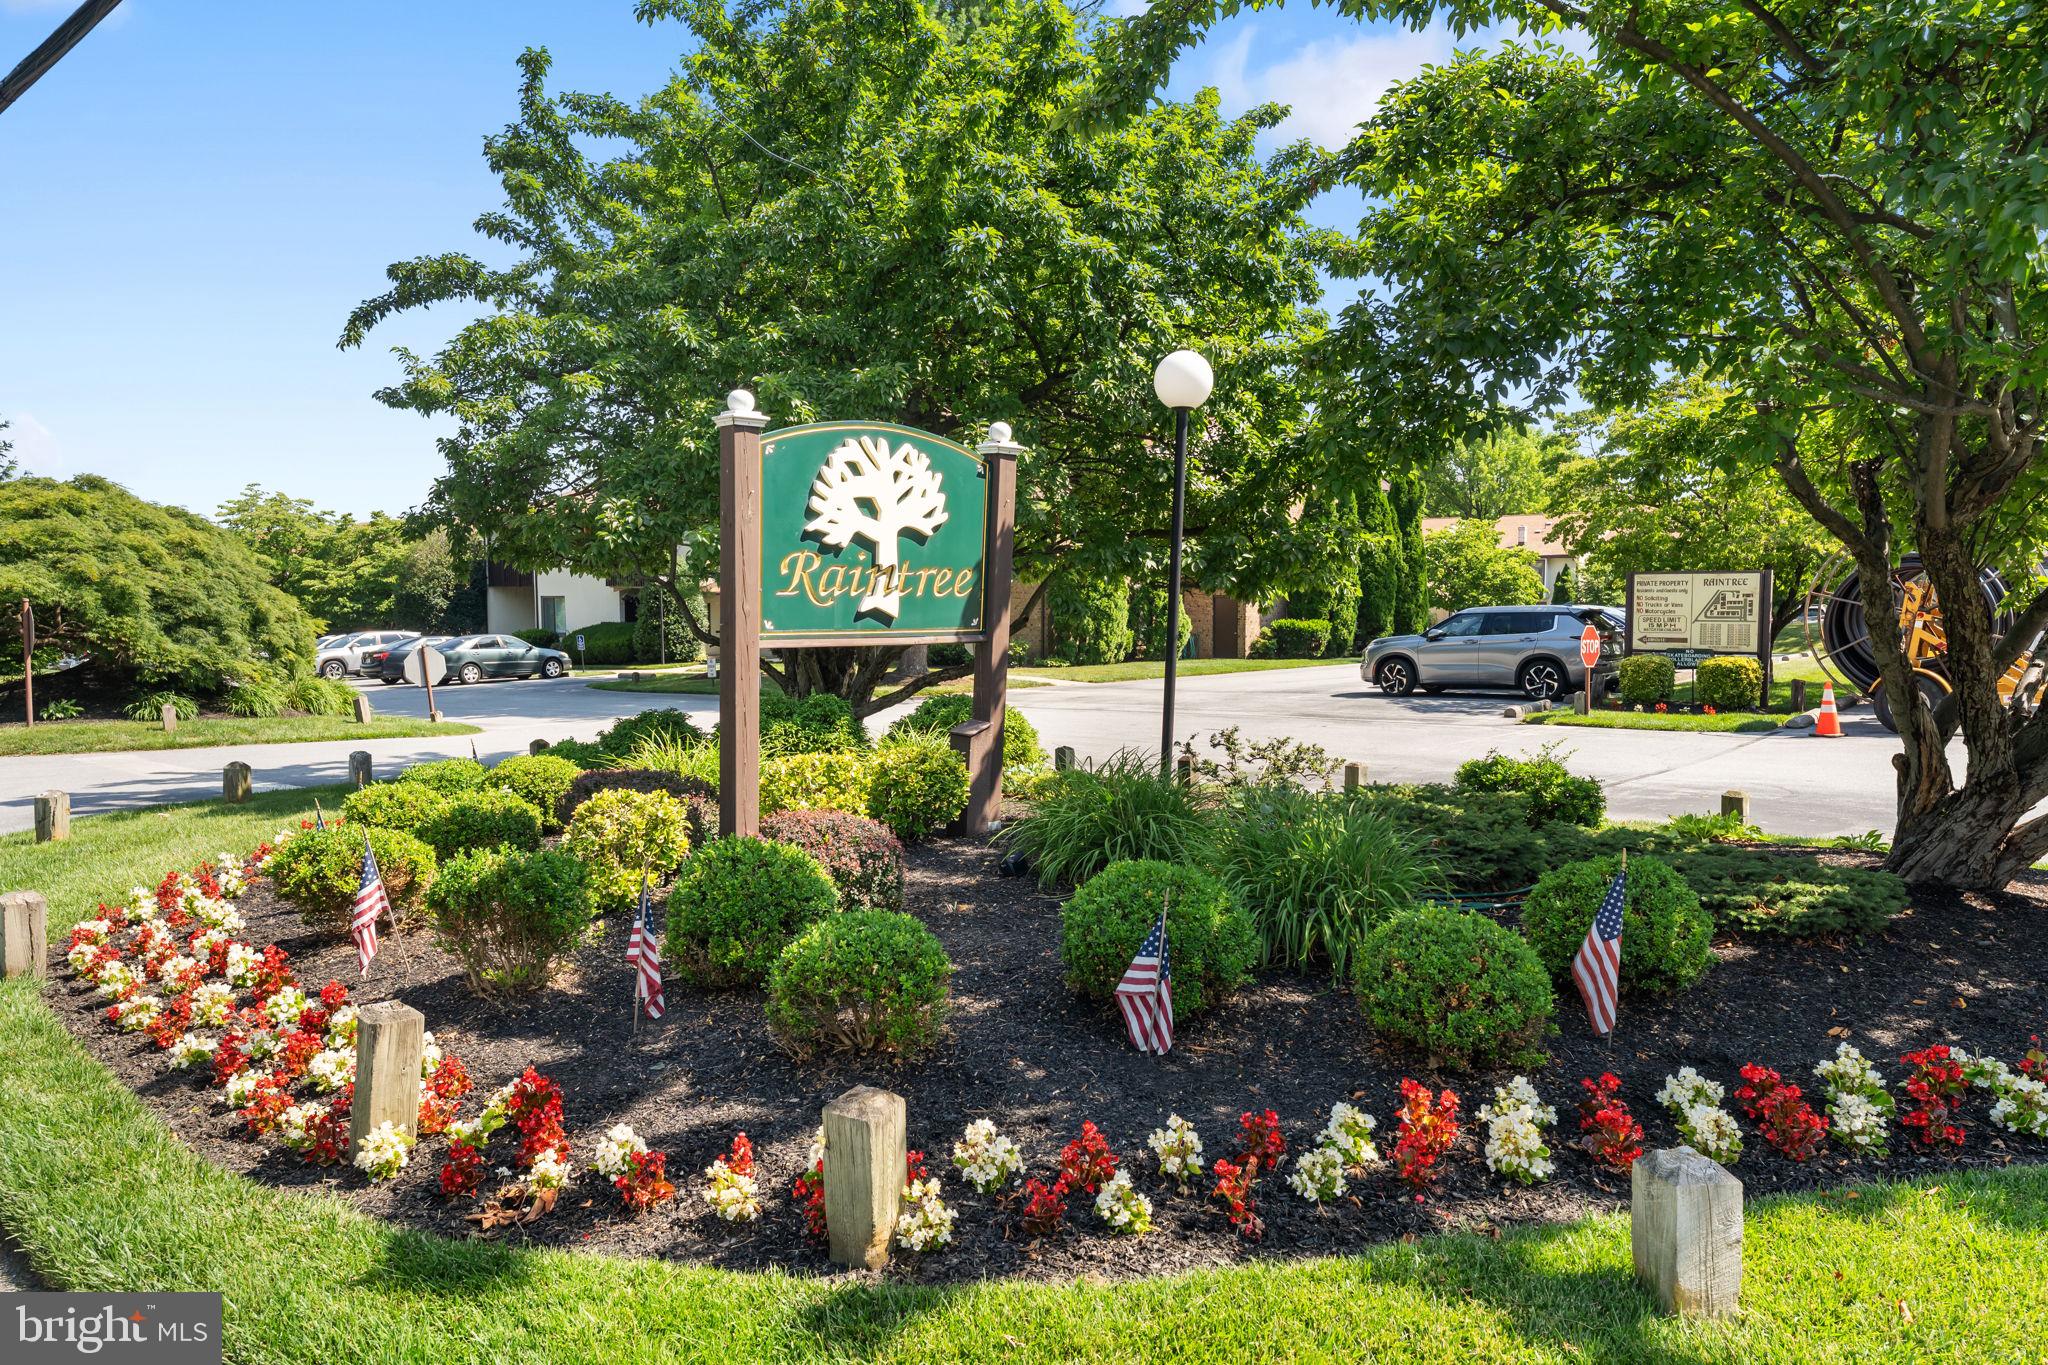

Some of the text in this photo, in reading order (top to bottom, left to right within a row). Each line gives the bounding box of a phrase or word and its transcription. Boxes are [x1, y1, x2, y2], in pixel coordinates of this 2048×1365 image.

[776, 550, 973, 608] Raintree
[1703, 578, 1749, 587] RAINTREE
[1644, 595, 1669, 603] Soliciting
[1582, 639, 1599, 654] STOP
